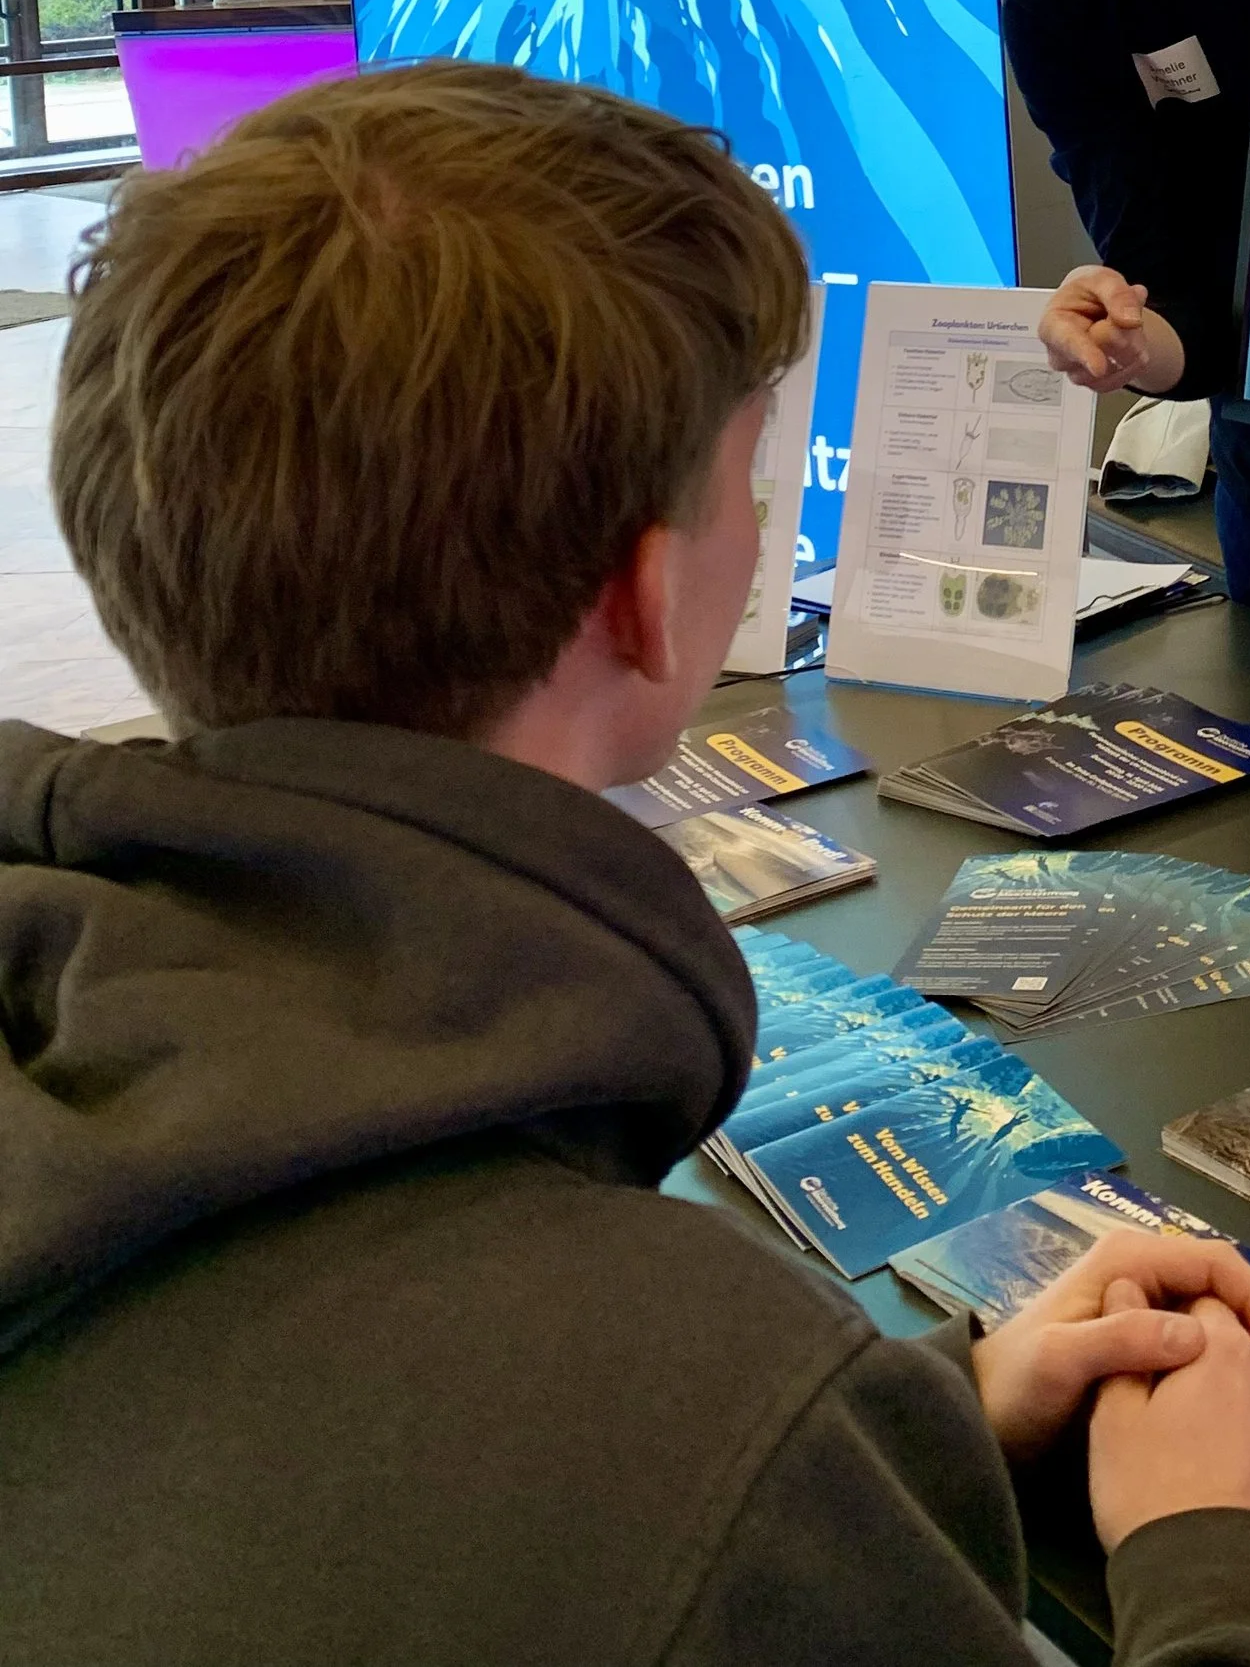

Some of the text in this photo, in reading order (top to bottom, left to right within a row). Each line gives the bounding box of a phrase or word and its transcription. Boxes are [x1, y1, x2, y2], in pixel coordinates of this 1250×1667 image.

[719, 739, 787, 786] Programm
[1127, 726, 1221, 777] Programm
[946, 910, 1068, 919] Schutz der Meere
[950, 902, 1087, 912] Gemeinsam für den
[846, 1133, 879, 1164] zum
[872, 1160, 930, 1221] Handeln
[875, 1127, 950, 1206] Vom Wissen
[1080, 1178, 1163, 1228] Komm
